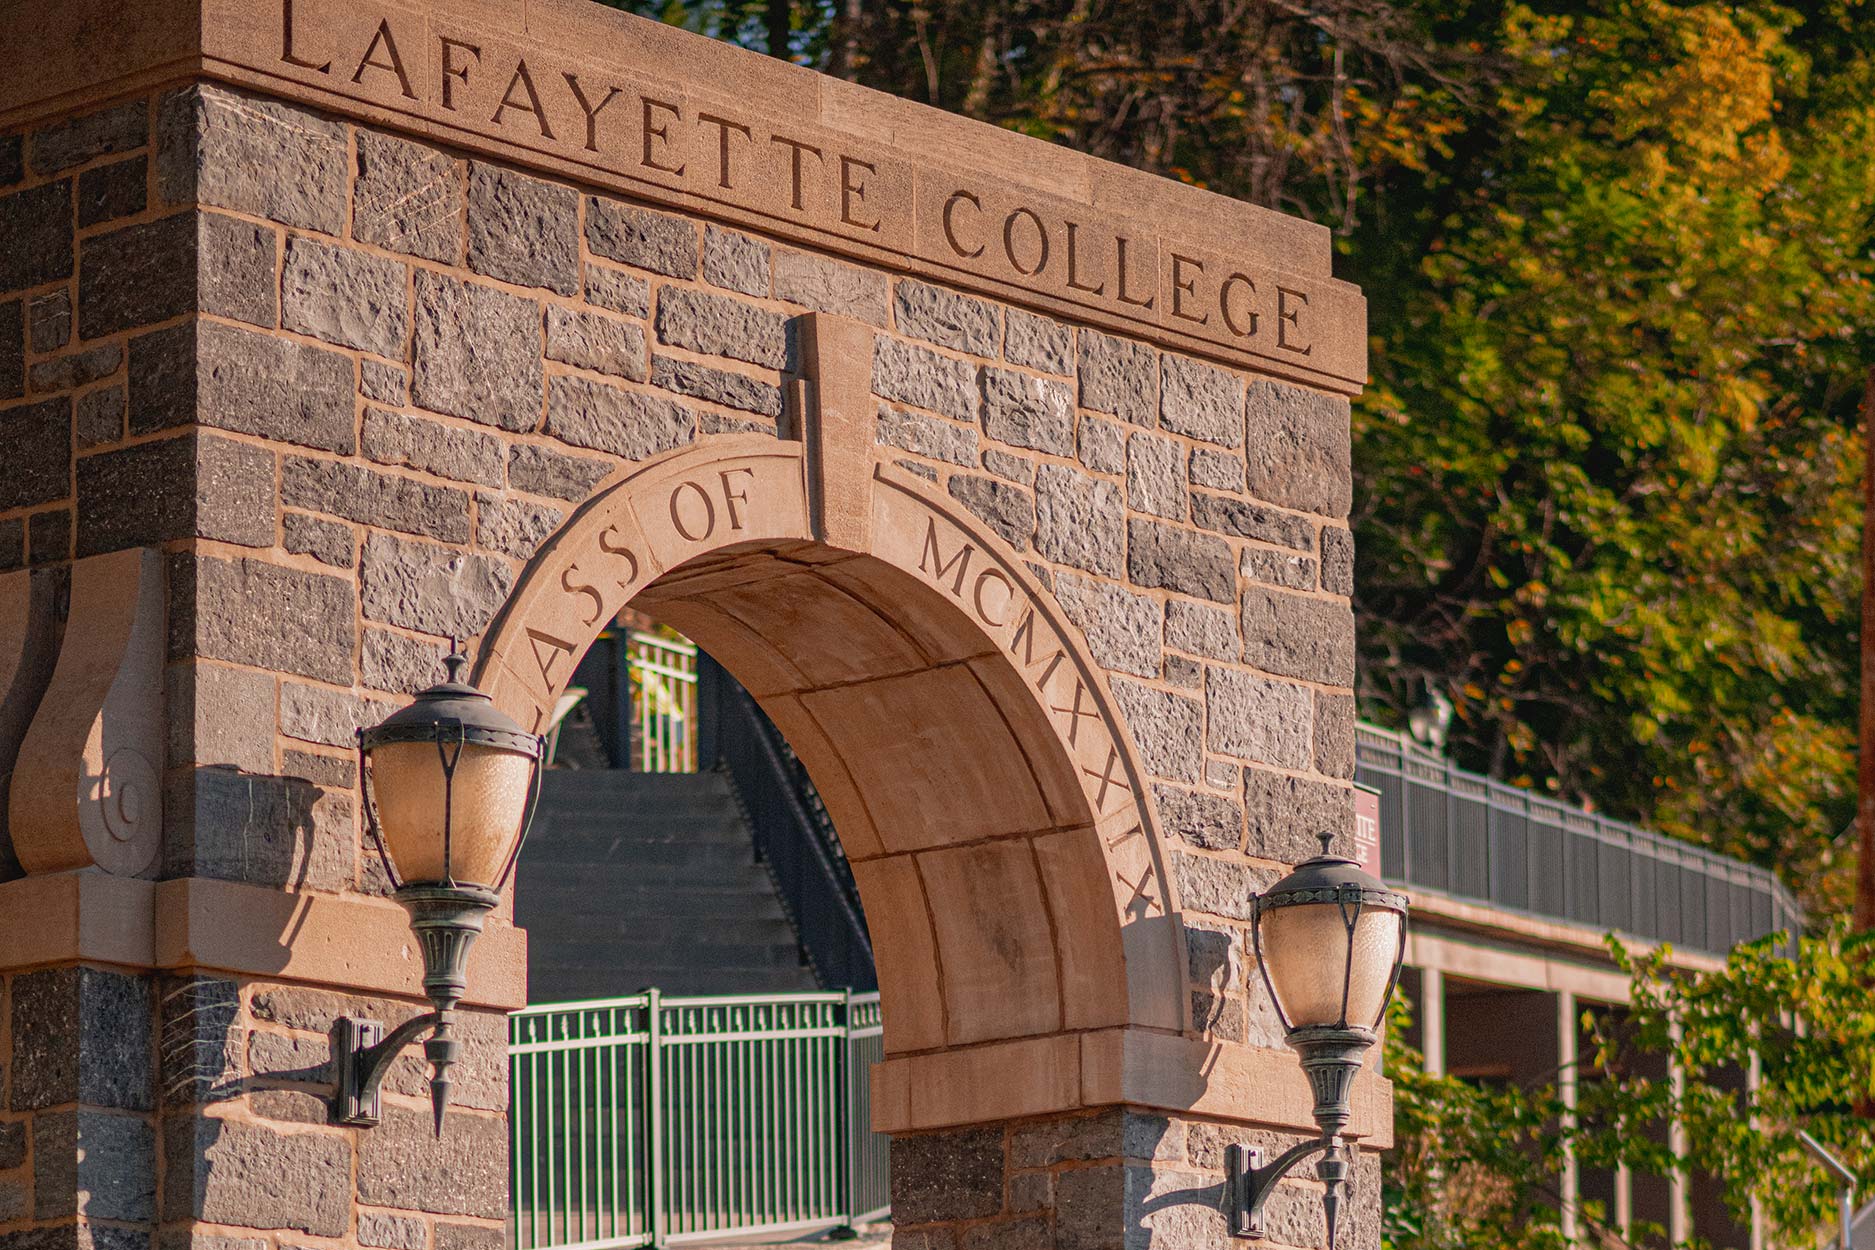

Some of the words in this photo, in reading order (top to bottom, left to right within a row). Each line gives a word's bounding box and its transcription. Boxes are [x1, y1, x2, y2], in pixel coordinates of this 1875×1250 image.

[281, 0, 881, 231] LAFAYETTE
[943, 189, 1312, 356] COLLEGE
[669, 467, 754, 542] OF
[918, 516, 1162, 920] MCMXXIX
